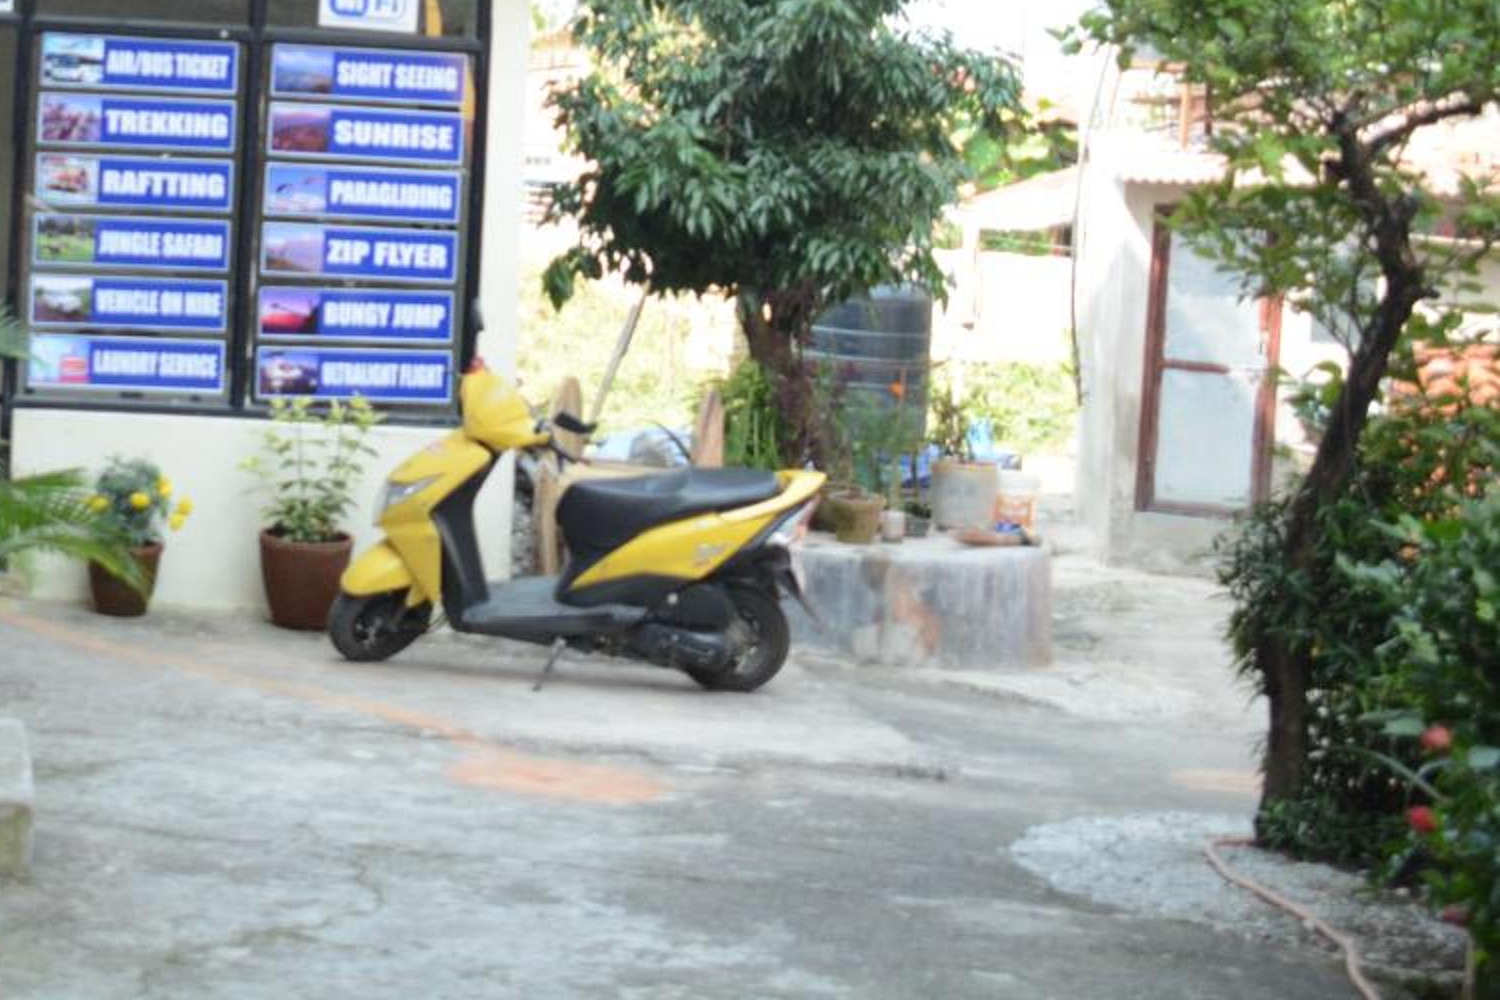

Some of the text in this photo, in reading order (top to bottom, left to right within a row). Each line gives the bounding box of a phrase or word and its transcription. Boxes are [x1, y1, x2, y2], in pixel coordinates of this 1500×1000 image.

[175, 52, 230, 80] TICKET
[337, 60, 459, 92] SIGHT SEEING
[104, 108, 230, 140] TREKKING
[333, 118, 455, 151] SUNRISE
[101, 168, 227, 199] RAFTTING
[329, 178, 453, 212] PARAGLIDING
[98, 229, 224, 261] JUNGLE SAFARI
[326, 238, 449, 271] ZIP FLYER
[323, 301, 447, 331] BUNGY JUMP
[93, 349, 220, 381] LAUNDRY SERVICE
